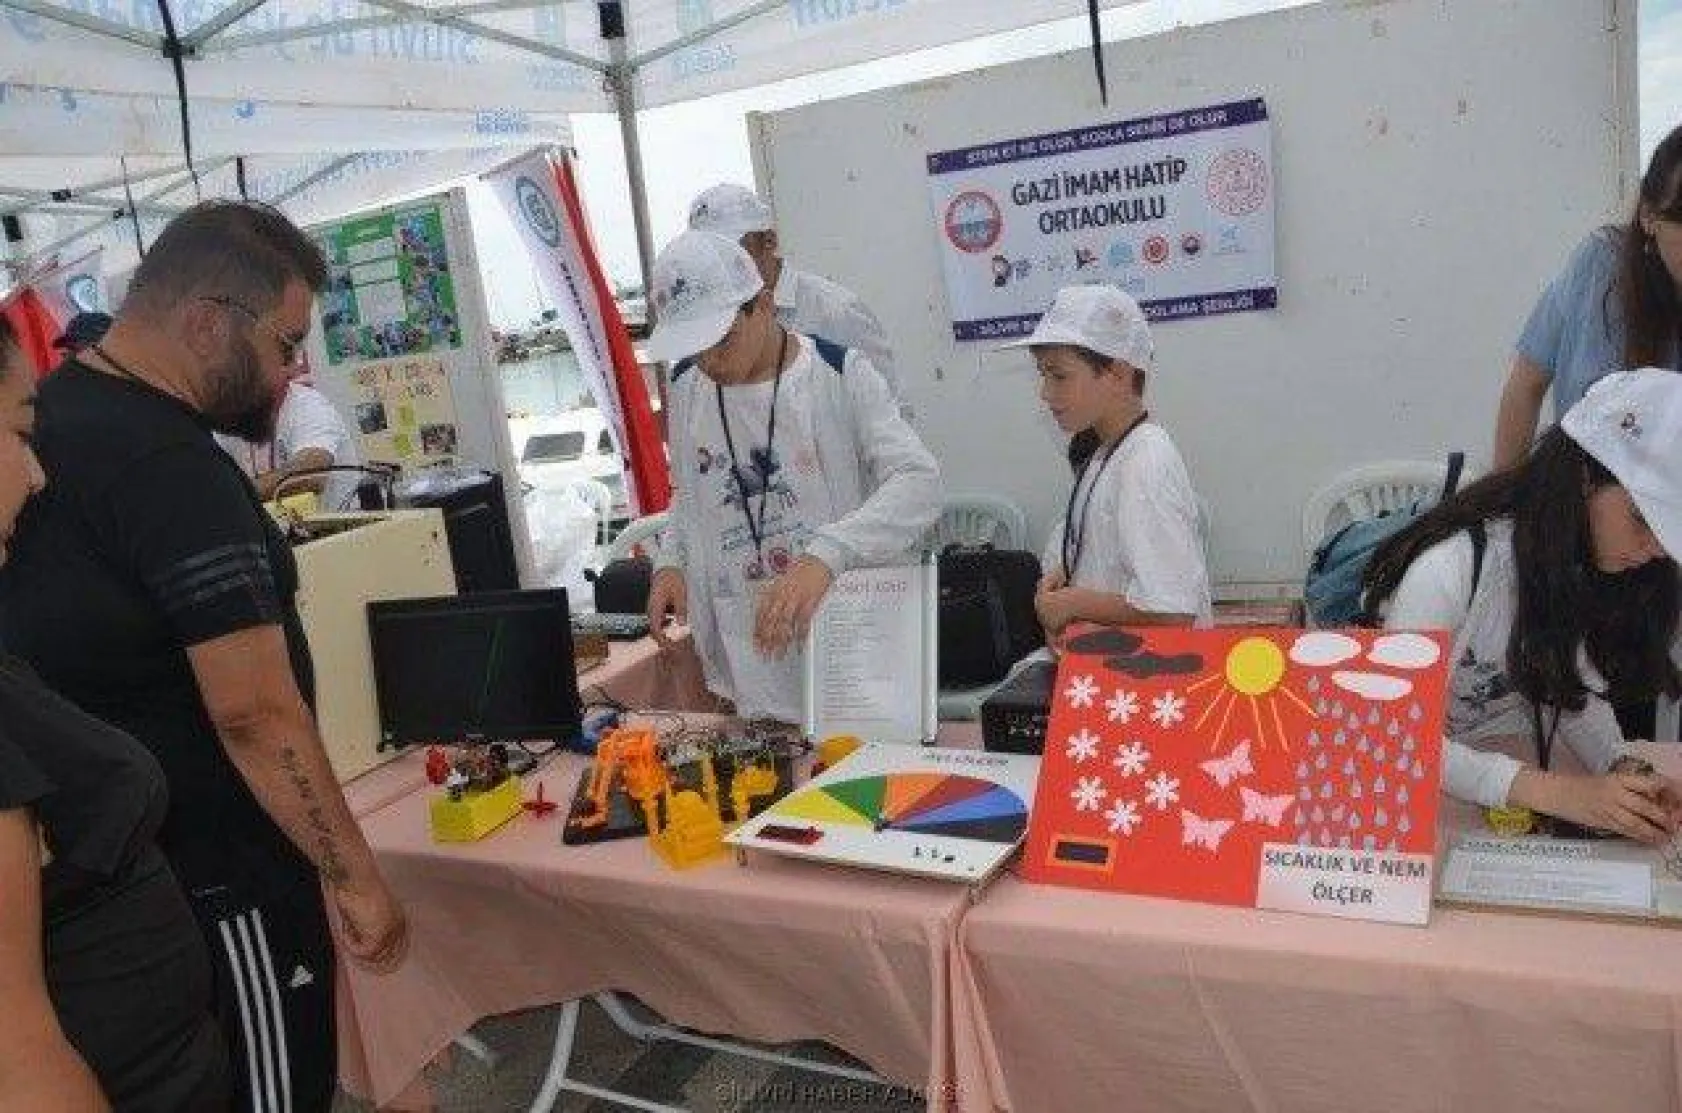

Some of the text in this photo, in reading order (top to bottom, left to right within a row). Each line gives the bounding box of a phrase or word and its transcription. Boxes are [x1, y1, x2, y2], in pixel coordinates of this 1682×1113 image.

[1012, 154, 1187, 206] GAZİ İMAM HATİP
[1039, 194, 1167, 235] ORTAOKULU
[1265, 851, 1426, 878] SICAKLIK VE NEM
[1312, 881, 1373, 906] ÖLÇER
